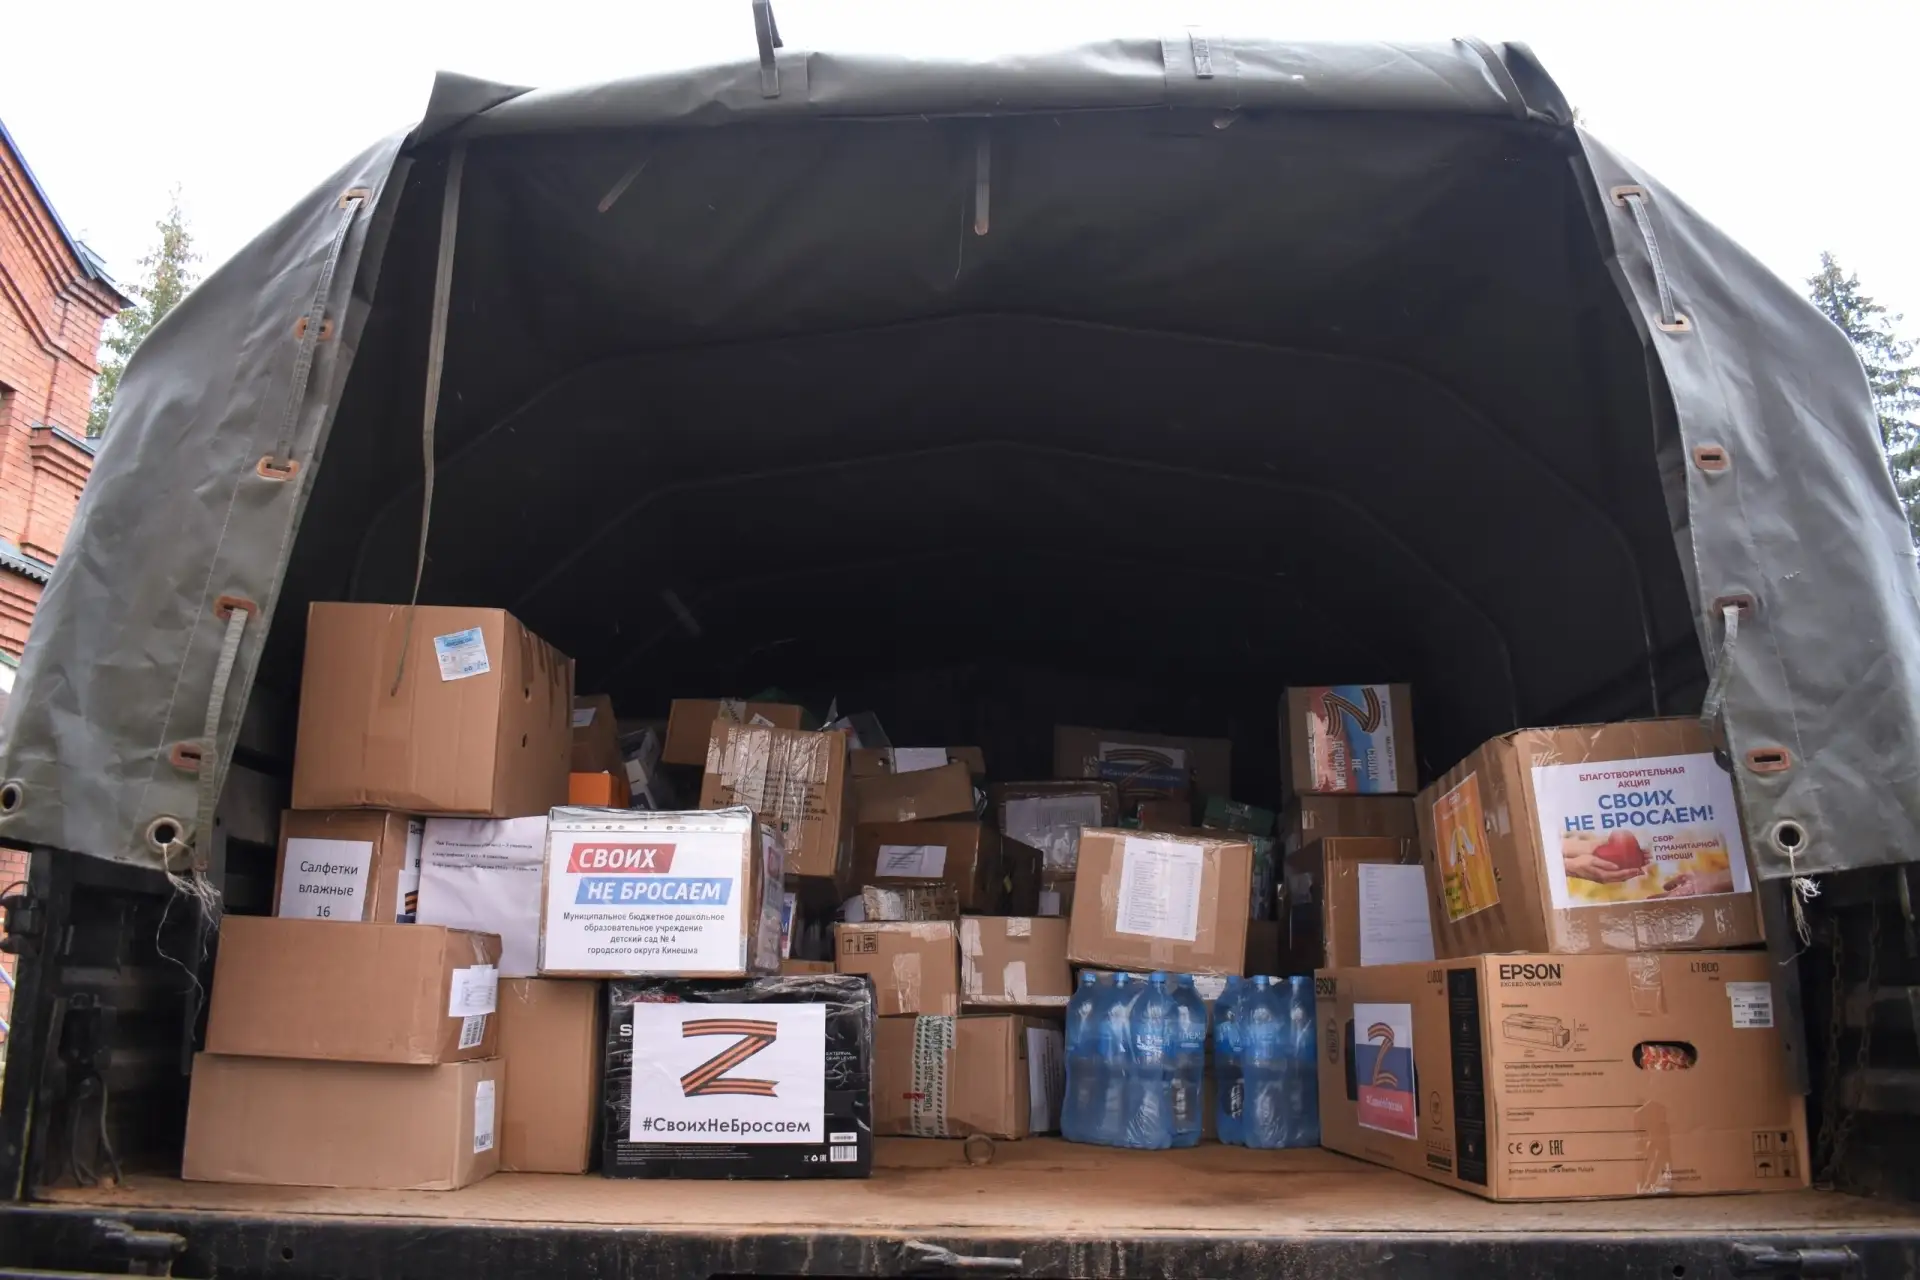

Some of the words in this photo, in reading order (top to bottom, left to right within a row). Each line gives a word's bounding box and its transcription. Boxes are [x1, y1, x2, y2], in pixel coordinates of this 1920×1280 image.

[1351, 758, 1363, 771] НЕ
[1365, 748, 1380, 781] СВОИХ
[1579, 766, 1686, 782] БЛАГОТВОРИТЕЛЬНАЯ
[1617, 778, 1651, 788] АКЦИЯ
[1598, 789, 1676, 810] СВОИХ
[1565, 814, 1595, 832] НЕ
[1601, 804, 1714, 829] БРОСАЕМ!
[1652, 835, 1675, 843] СБОР
[1653, 840, 1720, 852] ГУМАНИТАРНОЙ
[578, 848, 658, 868] СВОИХ
[1655, 852, 1694, 861] ПОМОЩИ
[300, 861, 359, 875] Салфетки
[298, 884, 354, 896] влажные
[587, 882, 616, 900] НЕ
[620, 882, 722, 900] БРОСАЕМ
[316, 905, 331, 918] 16
[563, 912, 627, 922] Муниципальное
[628, 912, 674, 922] бюджетное
[675, 912, 725, 922] дошкольное
[584, 923, 654, 933] образовательное
[655, 924, 703, 934] учреждение
[610, 934, 643, 944] детский
[644, 936, 659, 944] сад
[660, 935, 670, 943] №
[671, 935, 676, 943] 4
[587, 947, 632, 956] городского
[634, 947, 660, 956] округа
[662, 946, 698, 955] Кинешма
[1499, 964, 1561, 980] EPSON
[1690, 961, 1720, 973] L1800
[1315, 976, 1338, 996] EPSON
[922, 1081, 934, 1113] ТОВАРЫ
[642, 1116, 811, 1135] #СвоихНеБросаем
